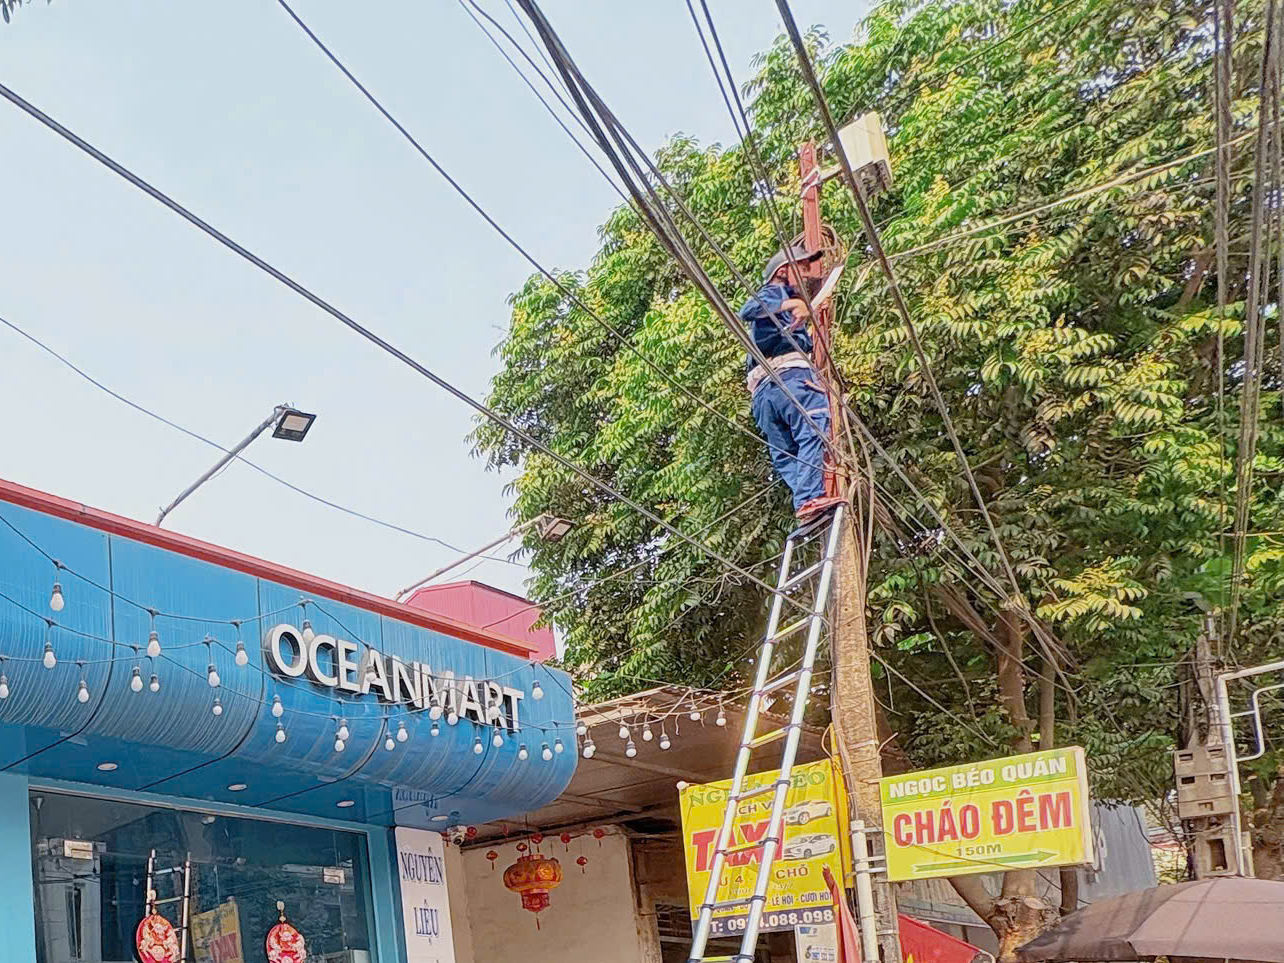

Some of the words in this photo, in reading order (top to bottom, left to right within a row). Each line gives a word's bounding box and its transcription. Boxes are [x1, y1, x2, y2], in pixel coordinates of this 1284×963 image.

[267, 623, 524, 732] OCEANMART
[889, 775, 947, 799] NGỌC
[952, 767, 996, 790] BÉO
[1002, 757, 1067, 783] QUÁN
[893, 801, 981, 847] CHÁO
[992, 789, 1072, 835] ĐÊM
[400, 847, 443, 883] NGUYÊN
[956, 844, 1002, 856] 150M
[414, 899, 439, 944] LIỆU
